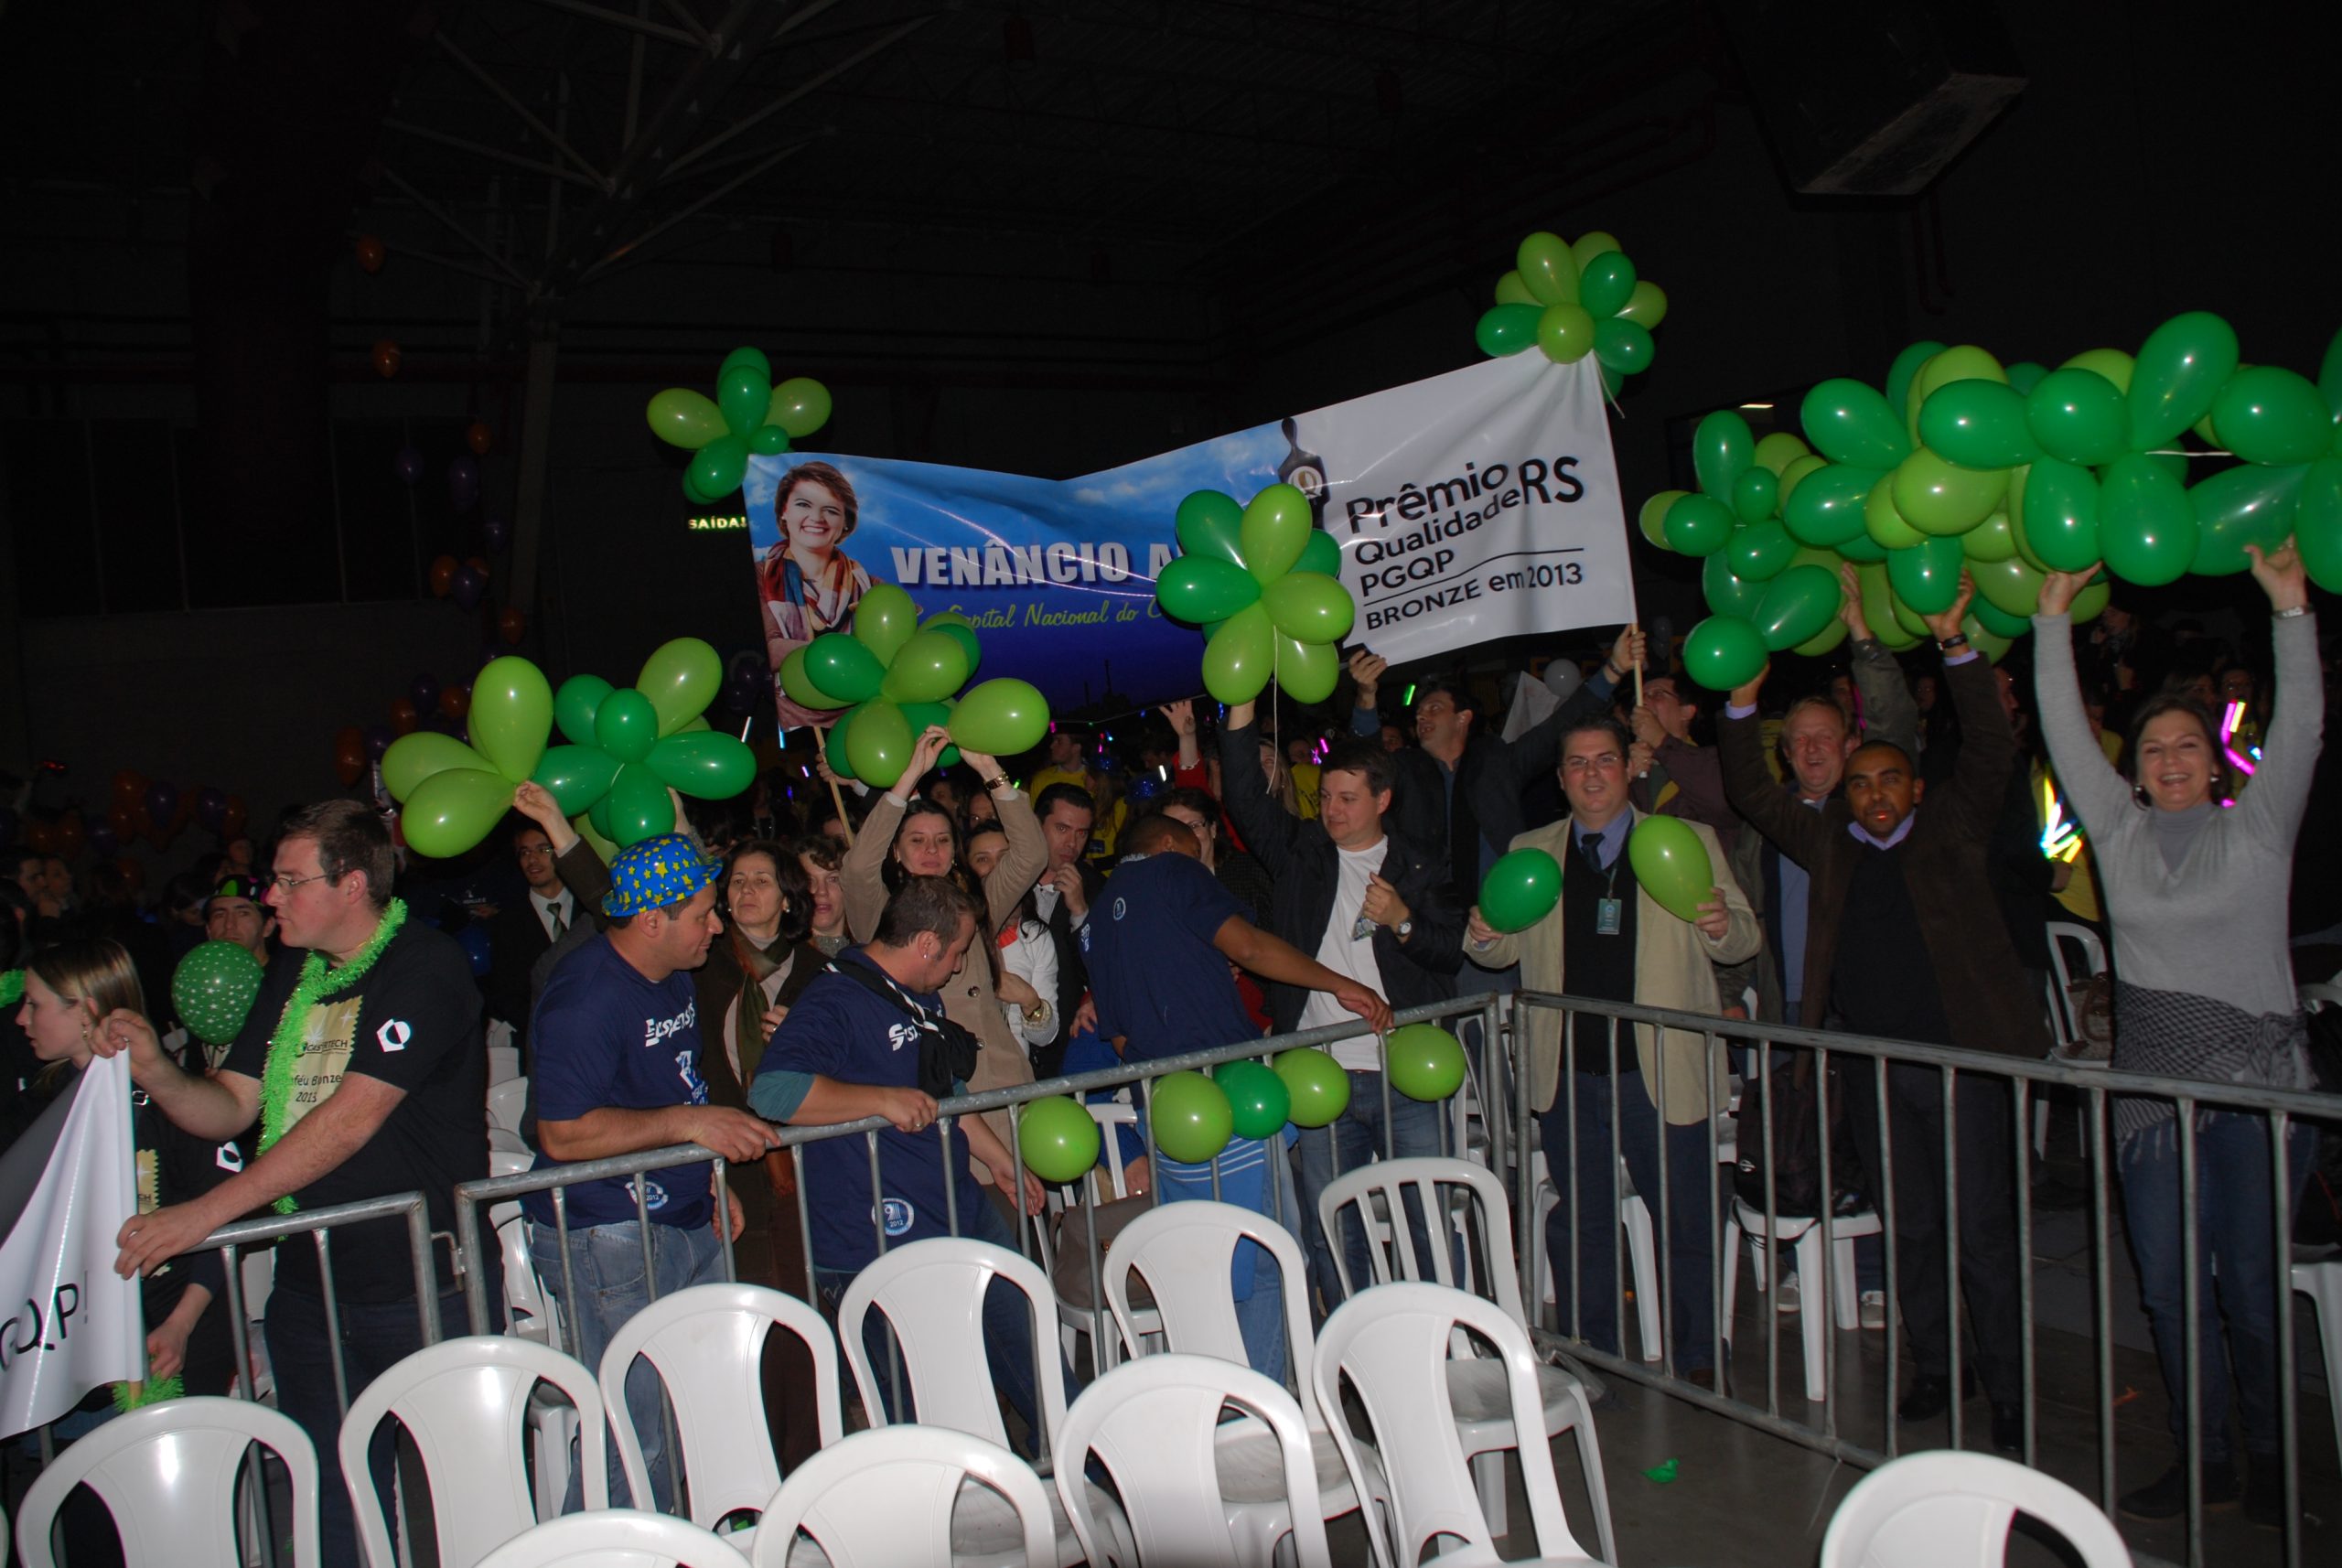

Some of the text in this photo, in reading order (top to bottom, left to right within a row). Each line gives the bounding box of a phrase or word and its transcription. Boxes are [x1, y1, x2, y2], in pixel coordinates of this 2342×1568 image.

[1346, 462, 1509, 534] Prêmio
[1519, 456, 1585, 504] RS
[1355, 489, 1520, 565] Qualidade
[891, 537, 1130, 585] VENÂNCIO
[1360, 549, 1455, 597] PGQP
[1025, 599, 1110, 628] Nacional
[1116, 602, 1140, 623] do
[1367, 563, 1583, 630] BRONZE em 2013
[295, 1091, 317, 1103] 2013
